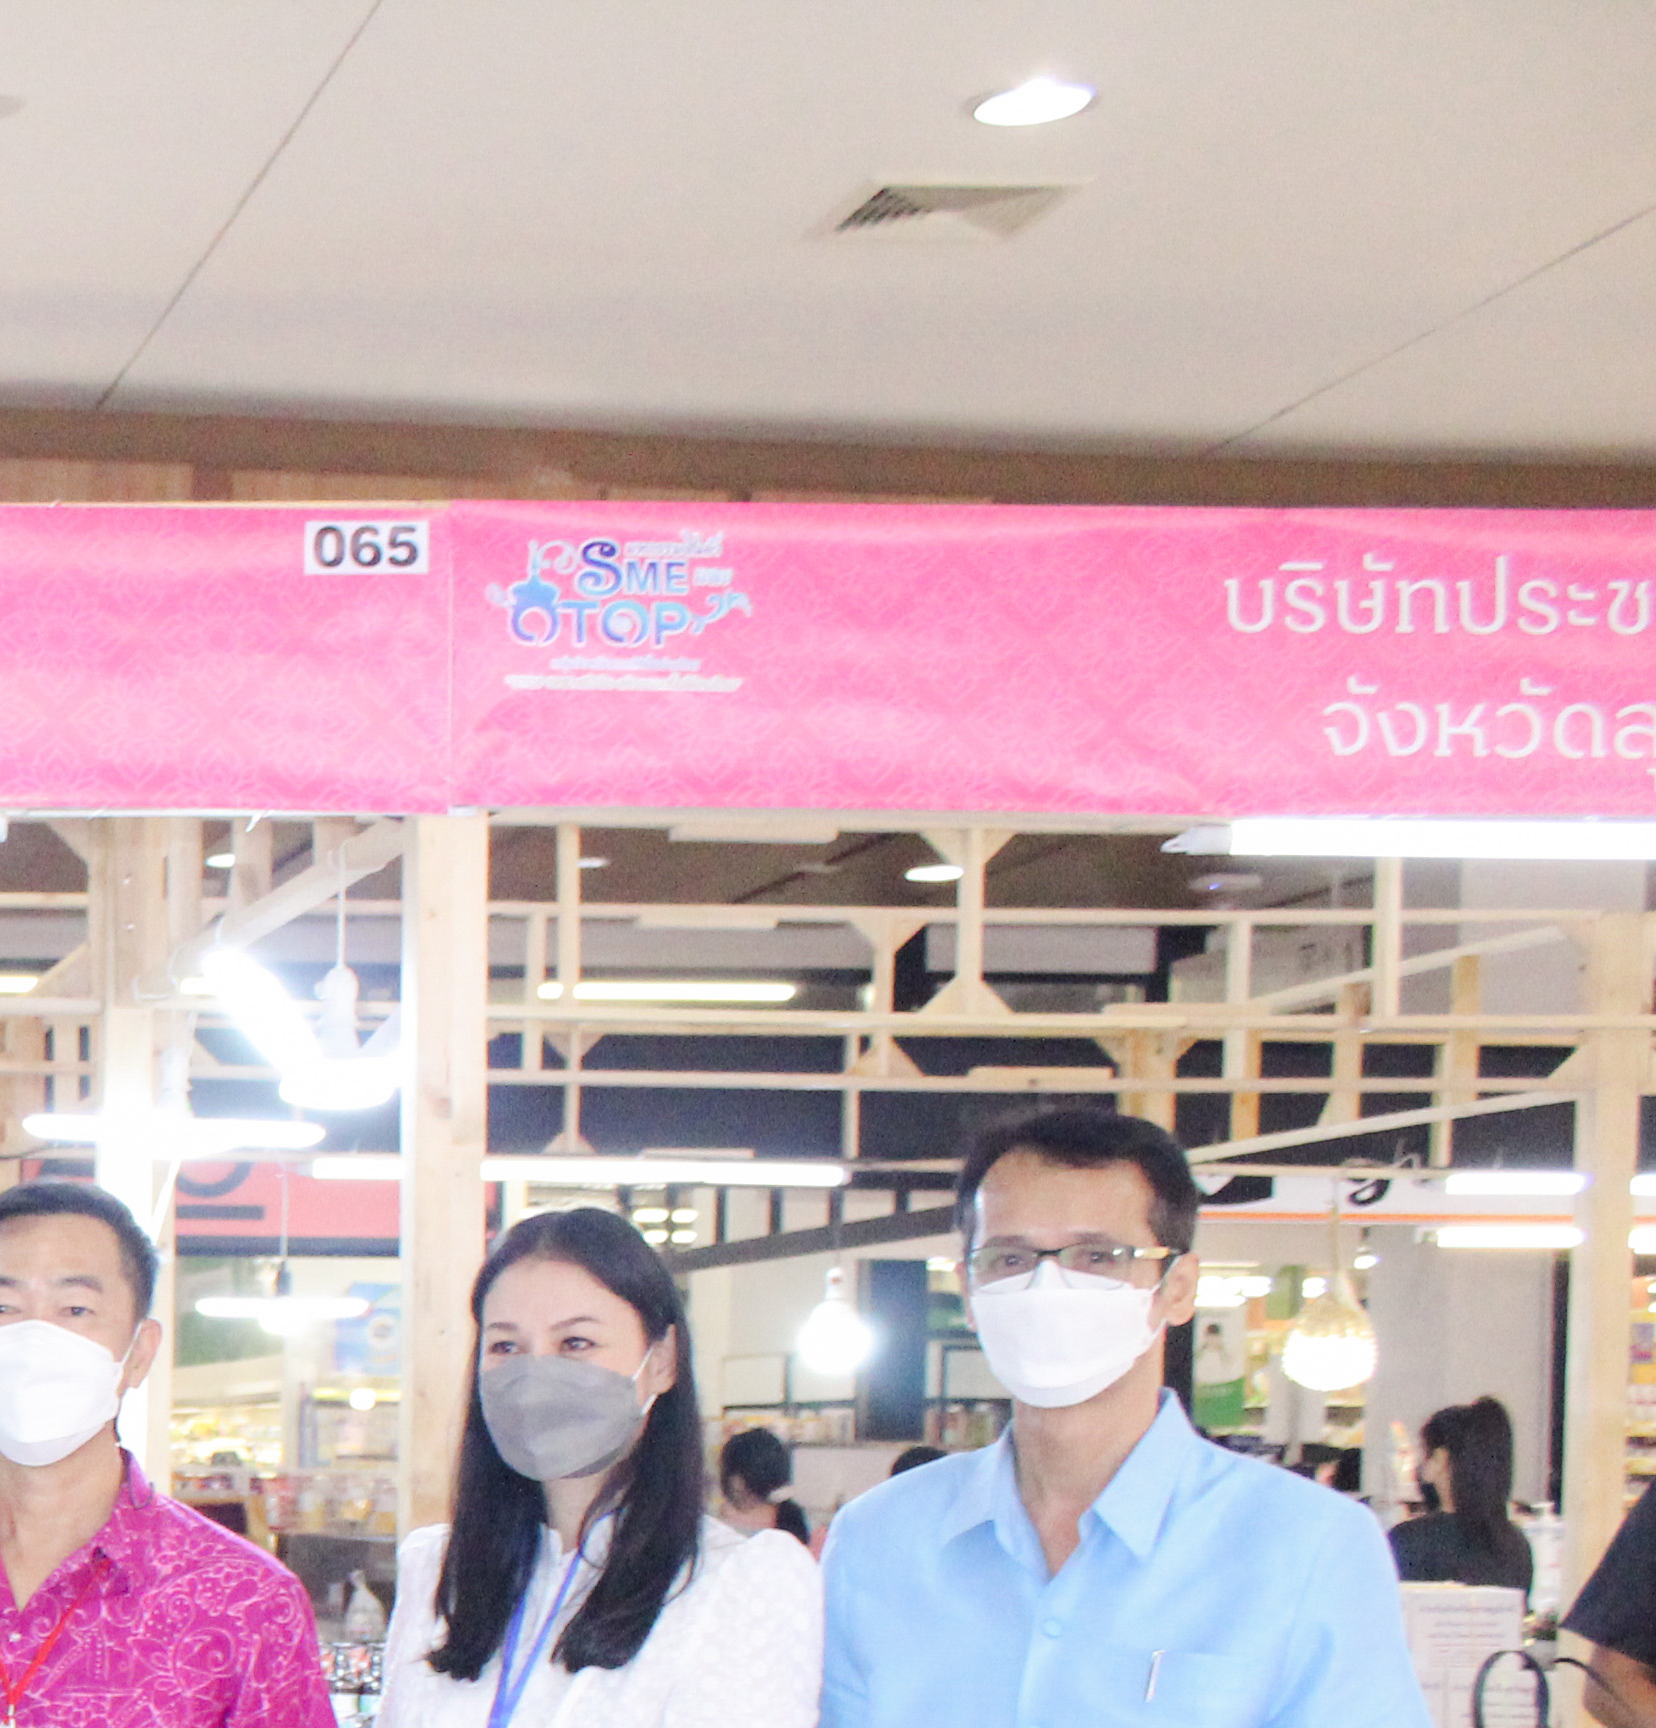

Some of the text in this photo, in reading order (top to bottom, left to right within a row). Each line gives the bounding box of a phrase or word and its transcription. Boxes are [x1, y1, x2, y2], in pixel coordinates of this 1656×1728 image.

[314, 526, 419, 568] 065
[576, 539, 691, 597] SME
[509, 600, 691, 648] OTOP
